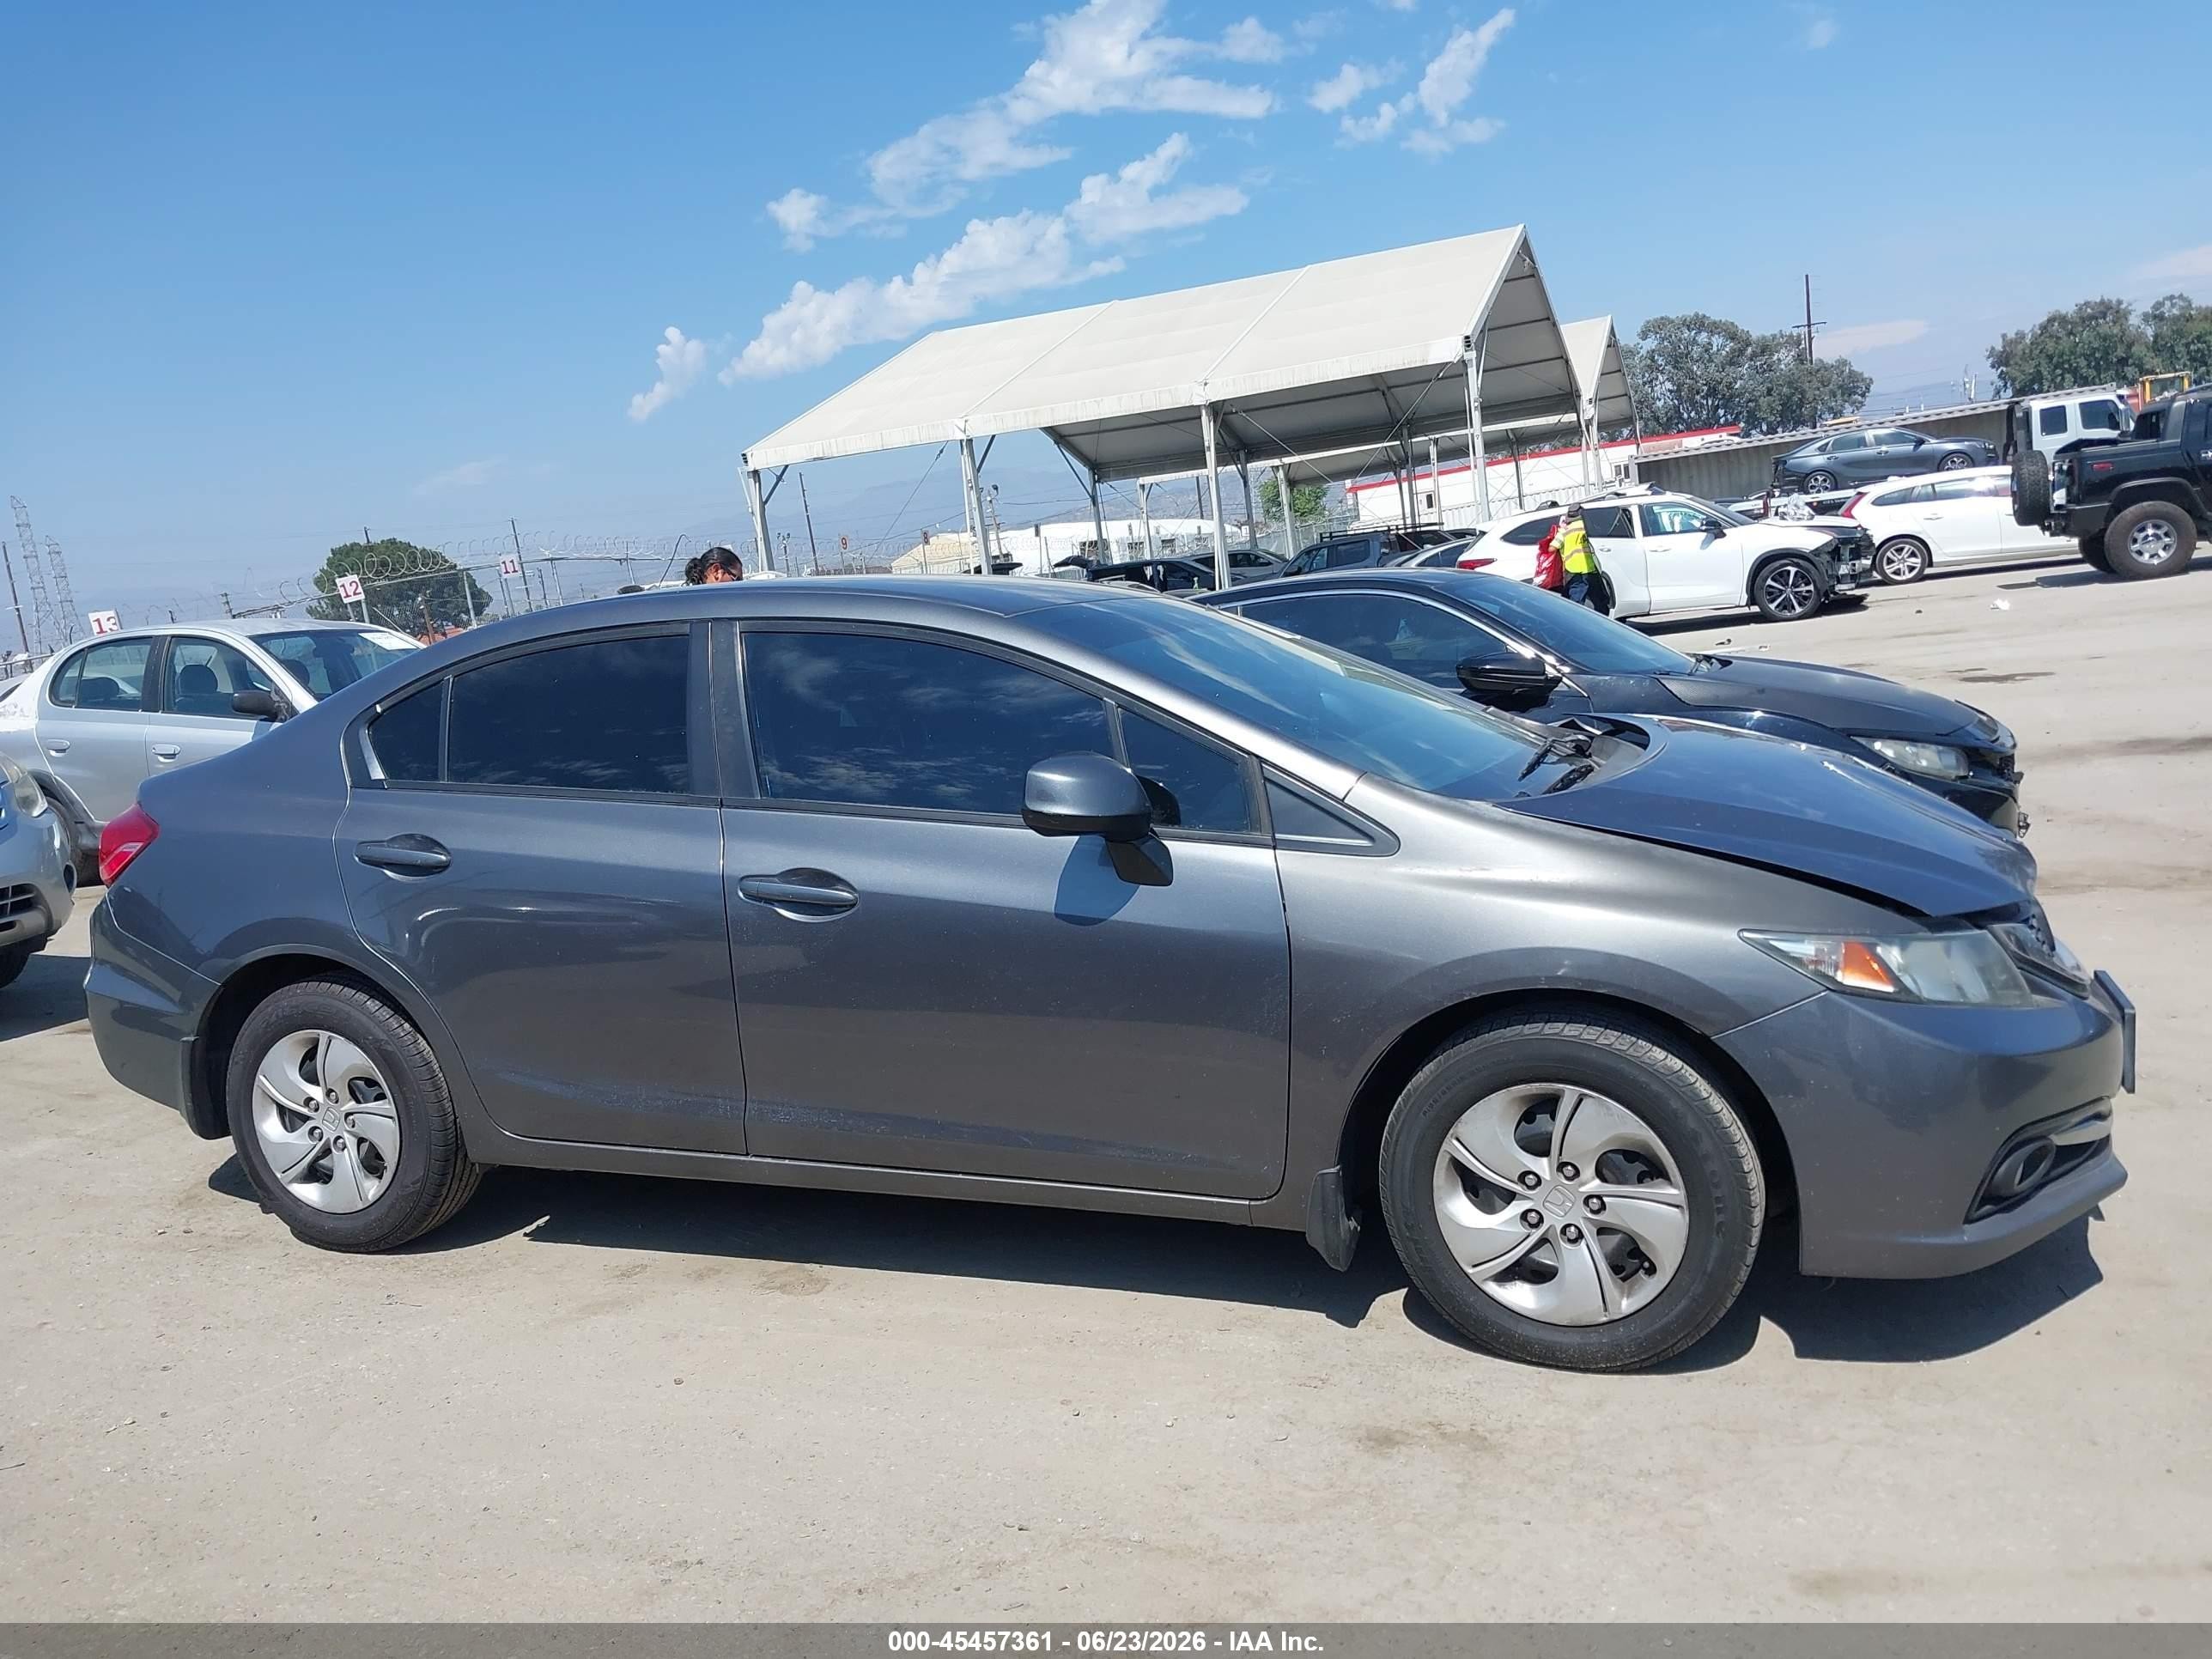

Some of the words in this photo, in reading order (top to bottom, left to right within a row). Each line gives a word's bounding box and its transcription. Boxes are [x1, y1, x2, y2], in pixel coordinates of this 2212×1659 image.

[842, 537, 848, 550] 9
[923, 532, 929, 544] 8
[501, 558, 519, 574] 11
[339, 580, 362, 599] 12
[92, 616, 119, 635] 13
